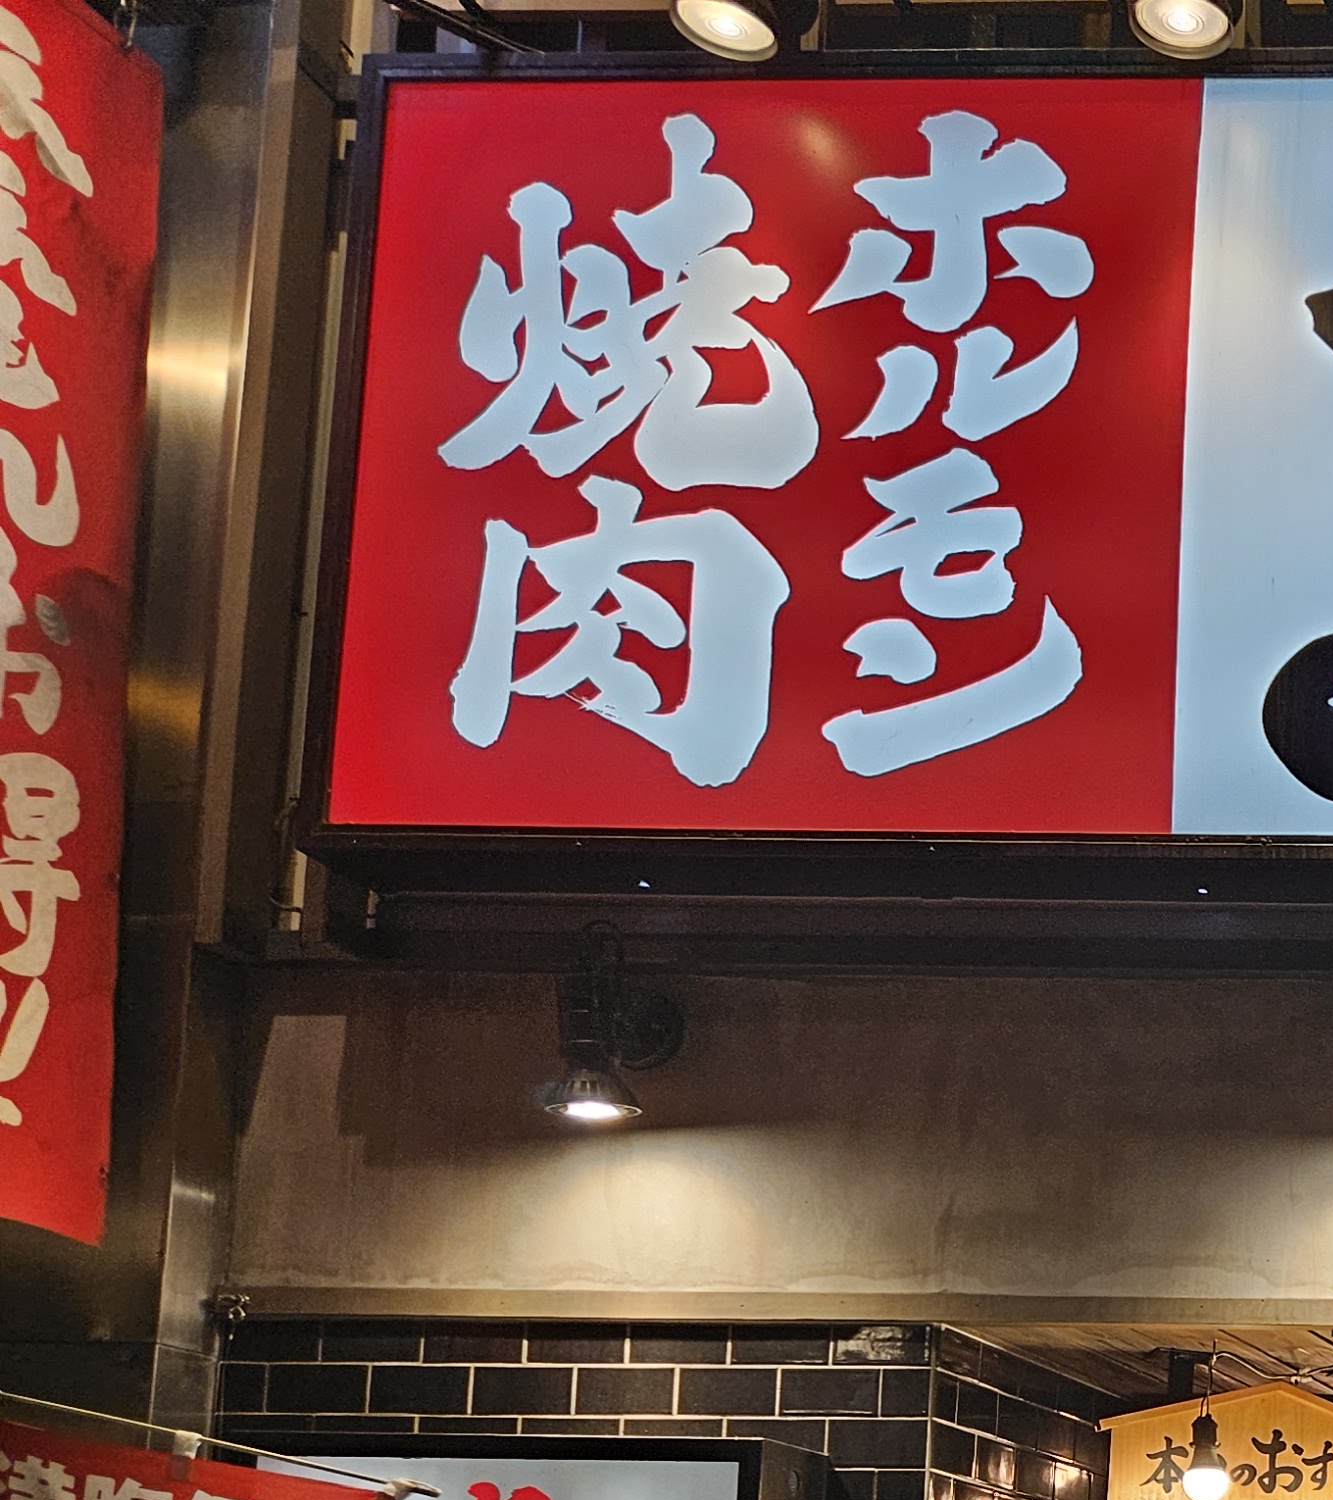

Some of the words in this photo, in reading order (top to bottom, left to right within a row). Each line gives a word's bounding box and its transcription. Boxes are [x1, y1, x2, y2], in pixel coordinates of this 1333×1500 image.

[439, 112, 819, 786] 焼肉
[809, 110, 1095, 777] ホルモン
